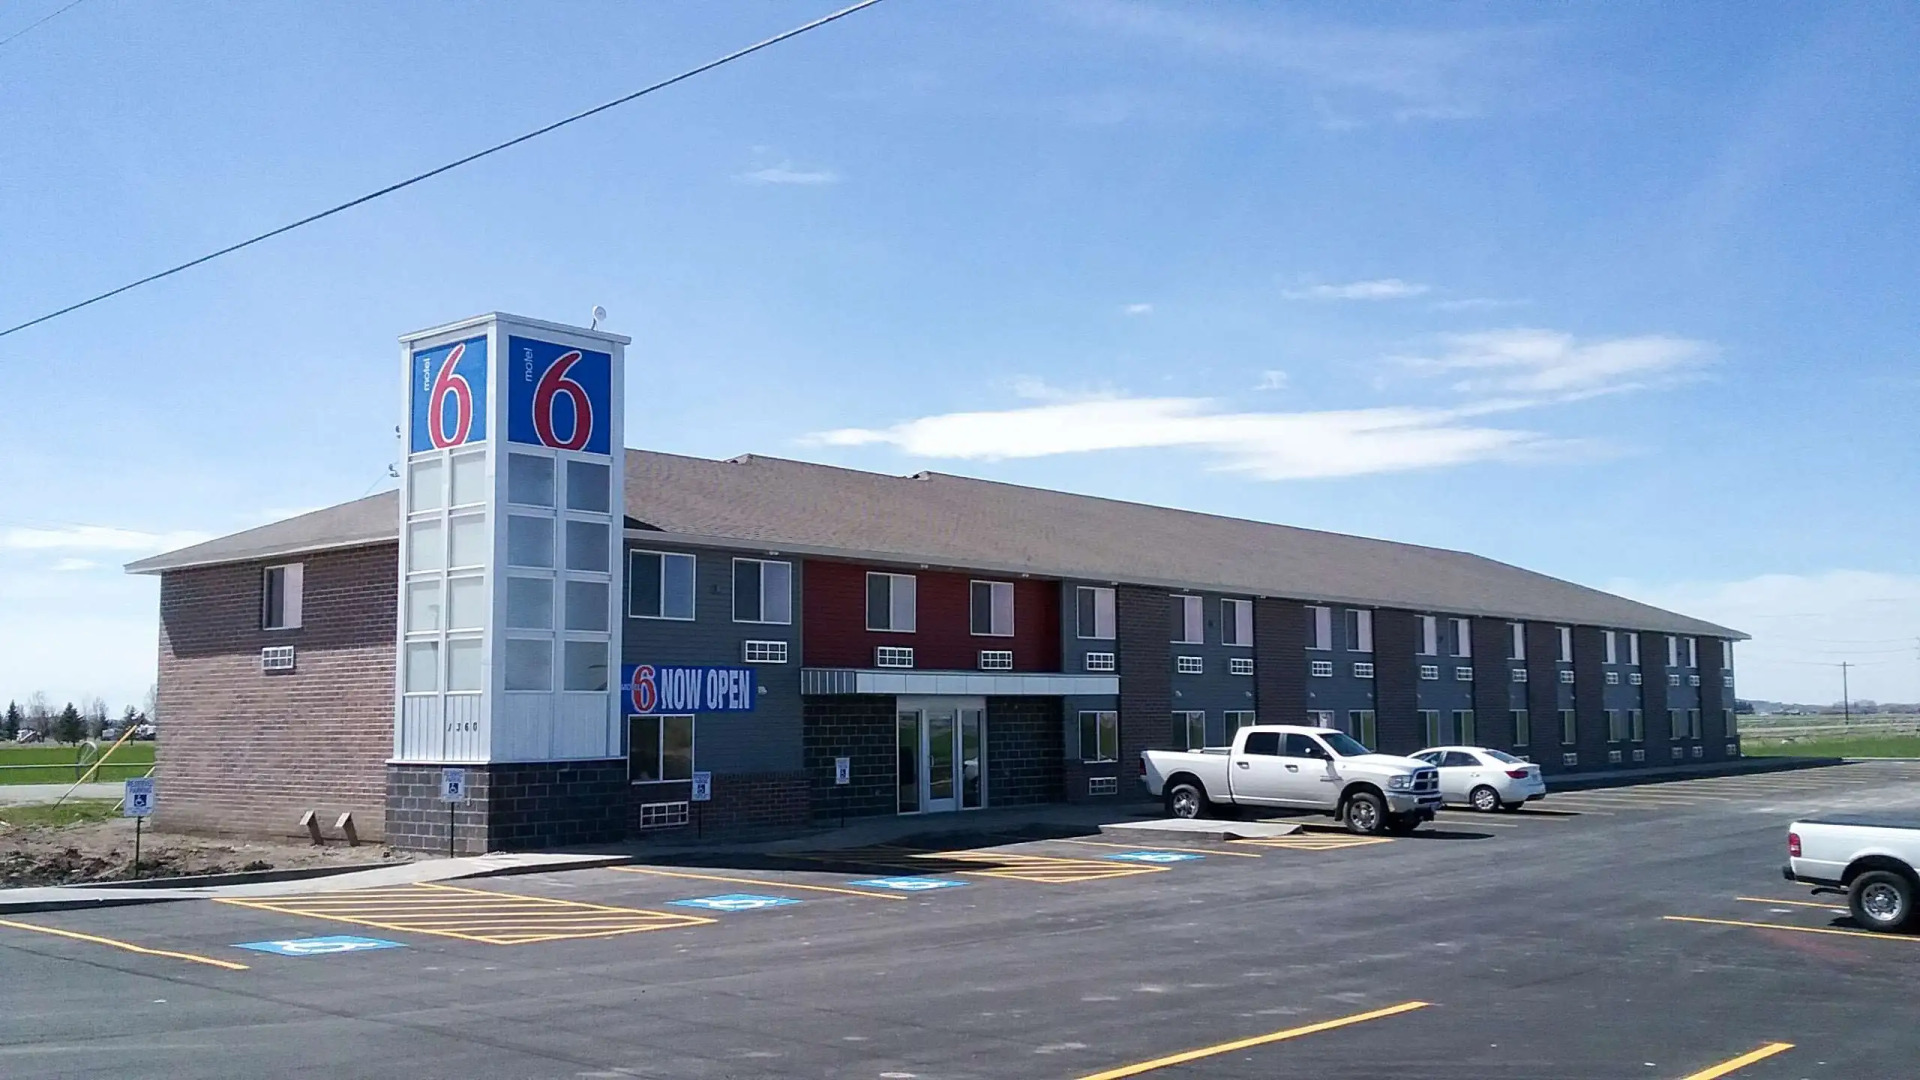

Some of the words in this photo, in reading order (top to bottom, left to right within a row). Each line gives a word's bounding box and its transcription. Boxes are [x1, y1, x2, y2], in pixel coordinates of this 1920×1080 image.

[428, 342, 473, 450] 6
[523, 347, 534, 382] motel
[532, 350, 593, 451] 6
[631, 664, 658, 714] 6
[661, 668, 703, 710] NOW
[706, 668, 750, 710] OPEN
